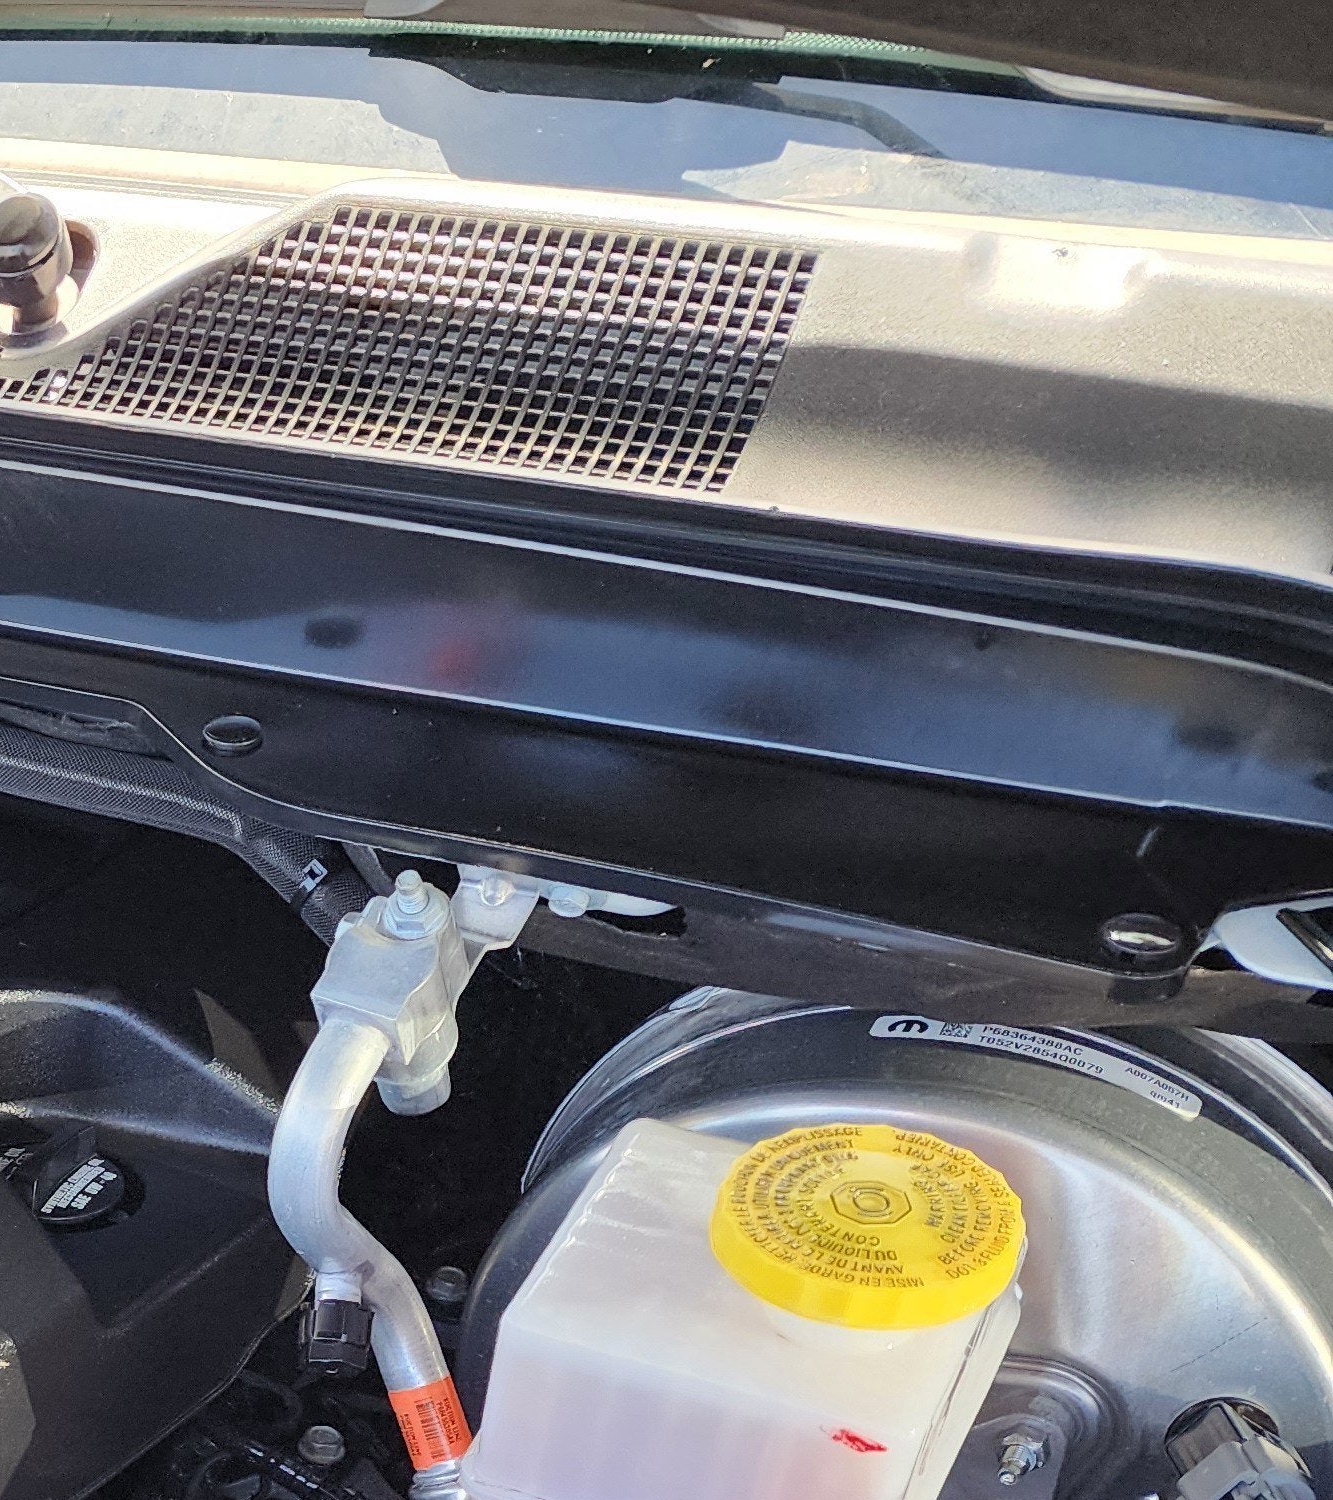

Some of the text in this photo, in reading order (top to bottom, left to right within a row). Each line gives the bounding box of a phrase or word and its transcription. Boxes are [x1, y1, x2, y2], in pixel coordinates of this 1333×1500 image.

[873, 1249, 899, 1261] DU
[849, 1260, 907, 1274] AVANT
[858, 1275, 881, 1286] EN
